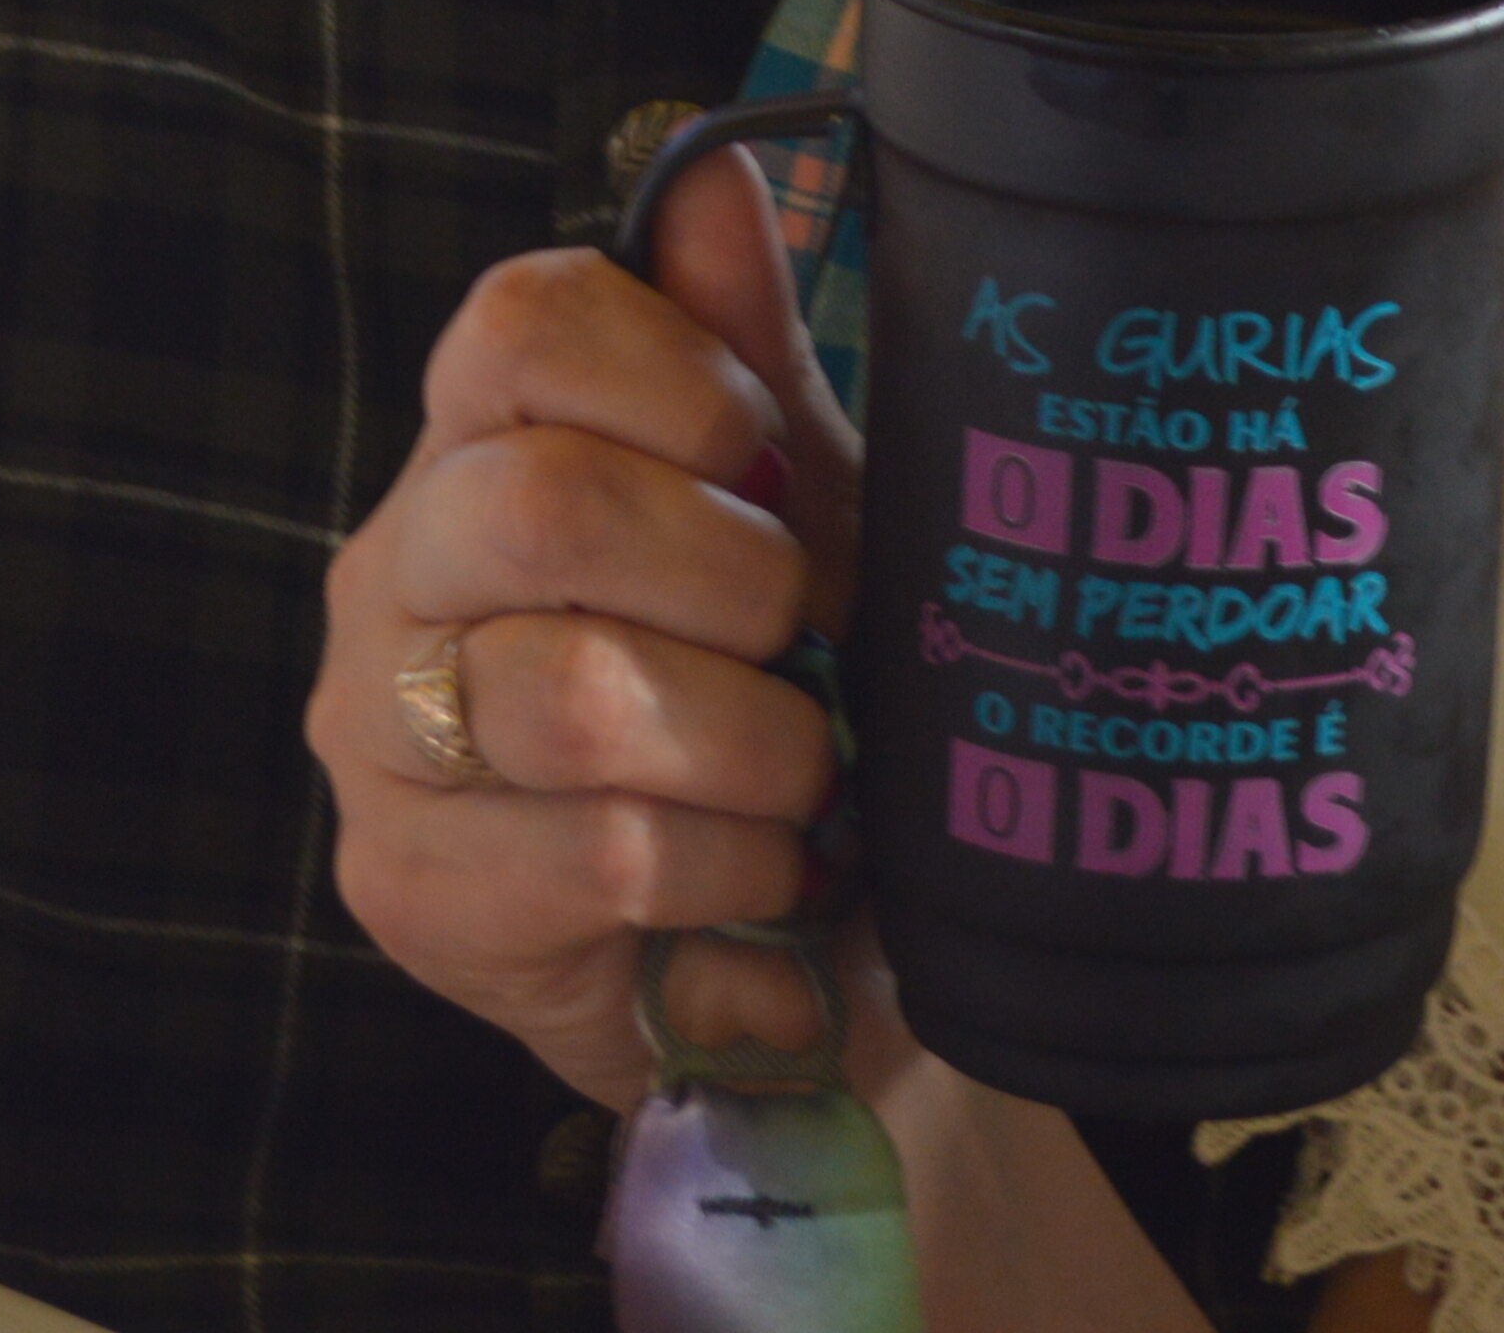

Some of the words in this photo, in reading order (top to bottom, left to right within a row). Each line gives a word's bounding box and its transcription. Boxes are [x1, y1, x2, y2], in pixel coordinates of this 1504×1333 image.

[963, 278, 1055, 374] AS
[1099, 302, 1401, 390] GURIAS
[1037, 394, 1211, 451] ESTÃO
[1228, 398, 1308, 451] HÁ
[1092, 460, 1388, 569] DIAS
[944, 546, 1058, 627] SEM
[1075, 573, 1388, 650] PERDOAR
[975, 693, 1015, 735] O
[1031, 706, 1300, 763] RECORDE
[1314, 700, 1348, 756] É
[1076, 771, 1369, 880] DIAS
